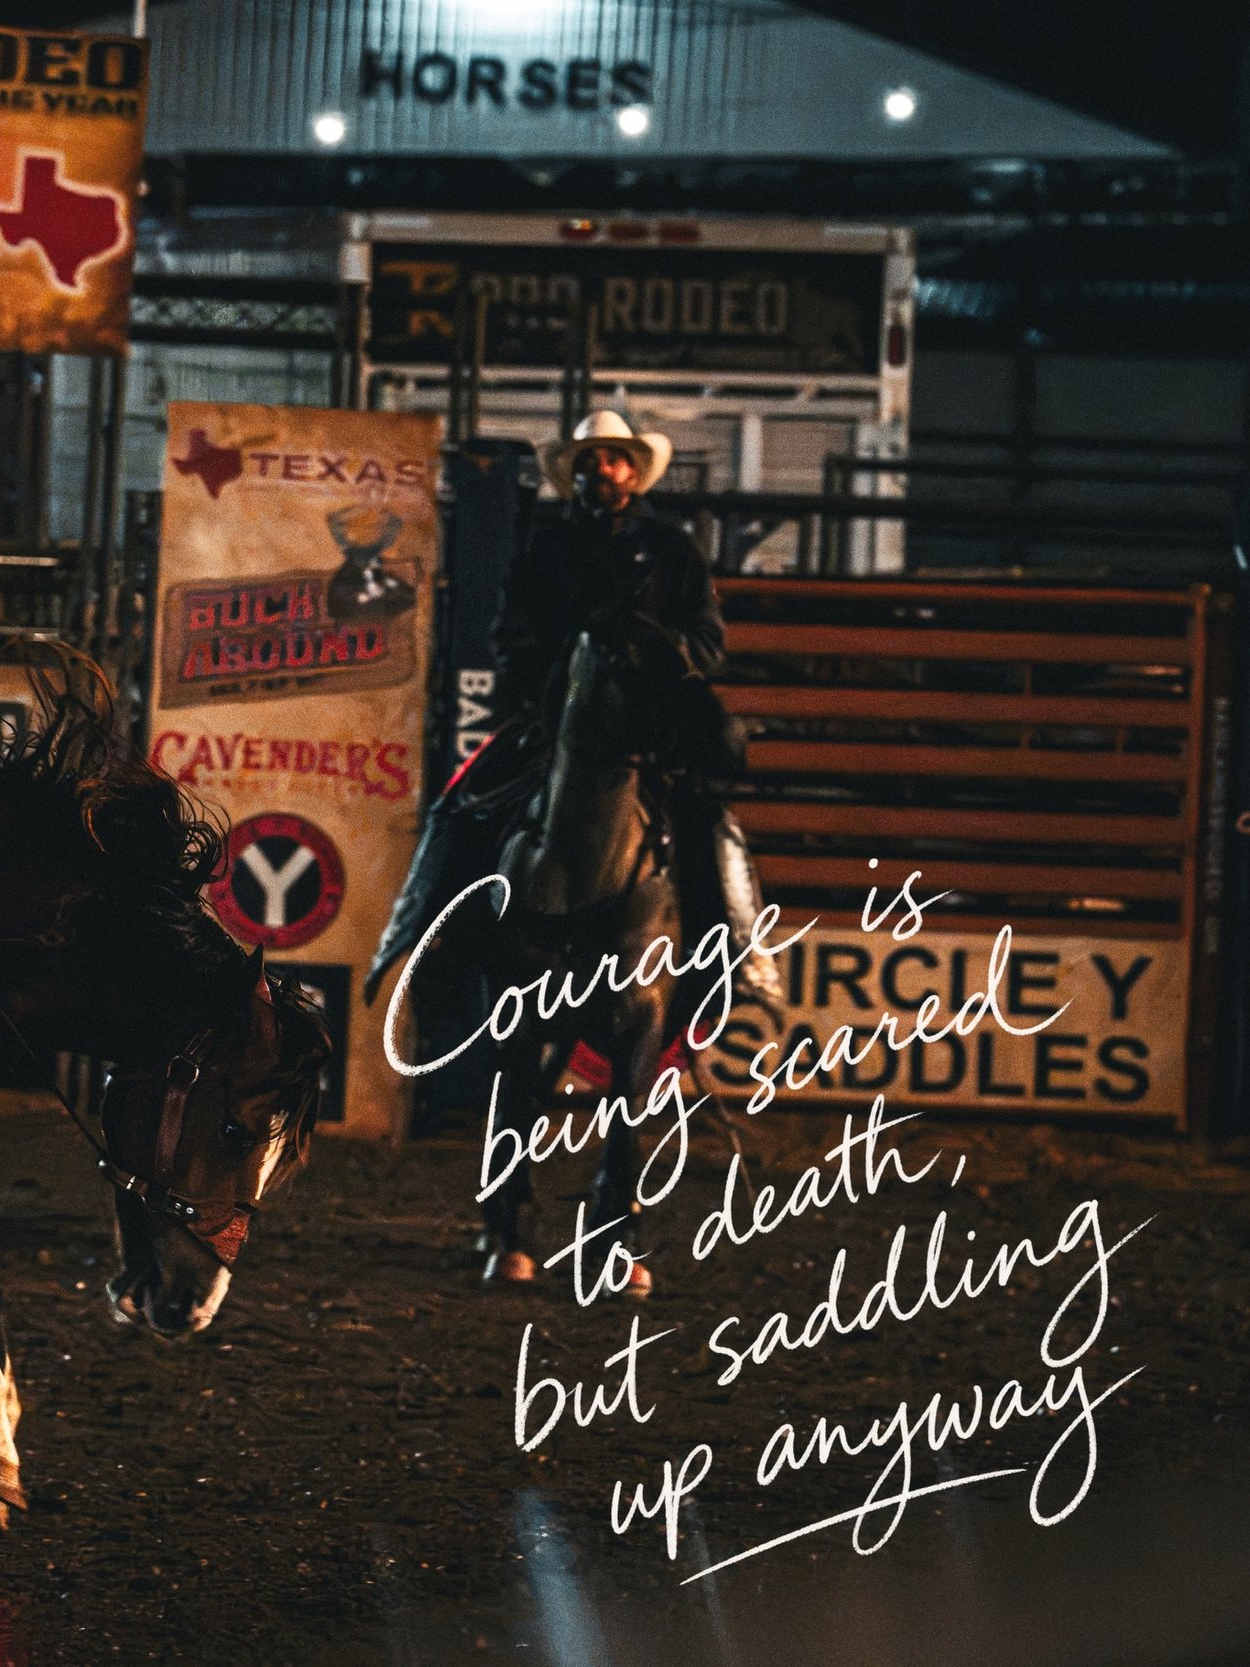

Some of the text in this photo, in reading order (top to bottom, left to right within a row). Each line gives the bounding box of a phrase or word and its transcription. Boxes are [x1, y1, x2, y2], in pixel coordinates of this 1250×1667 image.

[43, 92, 138, 119] YEAR
[360, 46, 654, 111] HORSES
[602, 275, 790, 337] RODEO
[250, 451, 427, 488] TEXAS
[150, 730, 410, 801] CAVENDER'S
[240, 842, 317, 929] Y
[786, 942, 1154, 1023] IRCLE Y
[710, 1017, 1151, 1103] SADDLES
